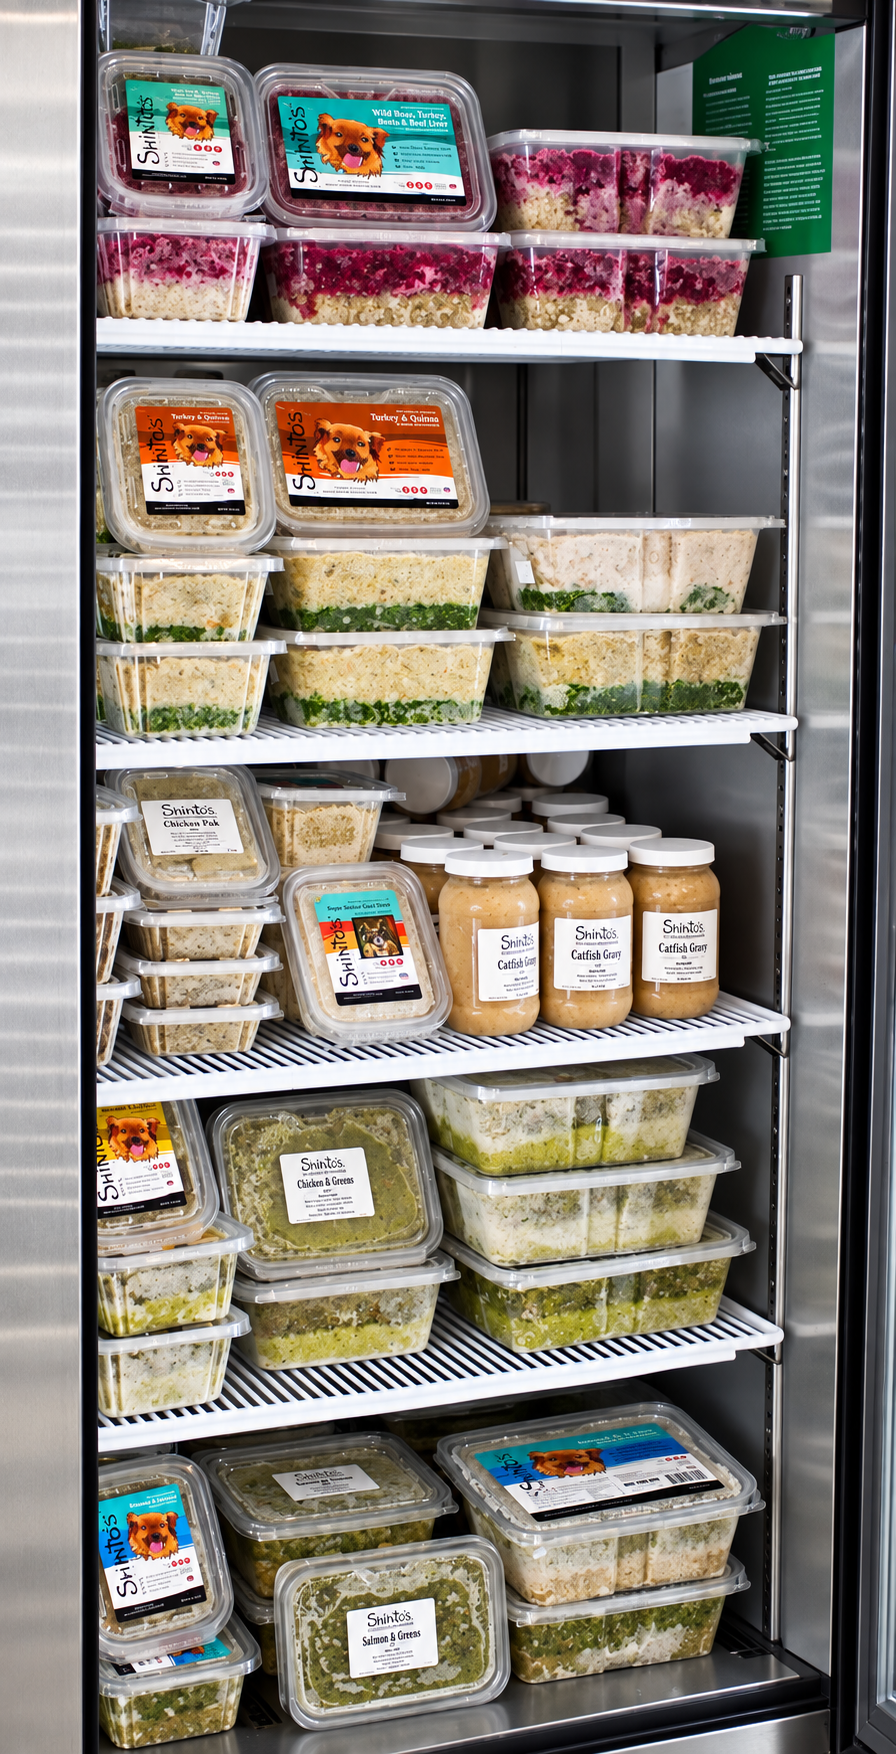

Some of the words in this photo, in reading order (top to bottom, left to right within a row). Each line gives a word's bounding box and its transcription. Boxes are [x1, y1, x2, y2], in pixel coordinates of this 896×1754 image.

[401, 413, 408, 422] &
[163, 820, 200, 828] Chicken
[202, 819, 220, 827] Pak
[658, 942, 687, 953] Catfish
[689, 942, 708, 953] Gravy
[571, 949, 601, 961] Catfish
[603, 949, 622, 960] Gravy
[497, 958, 524, 970] Catfish
[297, 1178, 324, 1189] Chicken
[325, 1177, 331, 1186] &
[332, 1176, 354, 1186] Greens
[362, 1635, 389, 1647] Salmon
[390, 1632, 396, 1641] &
[397, 1630, 421, 1641] Greens
